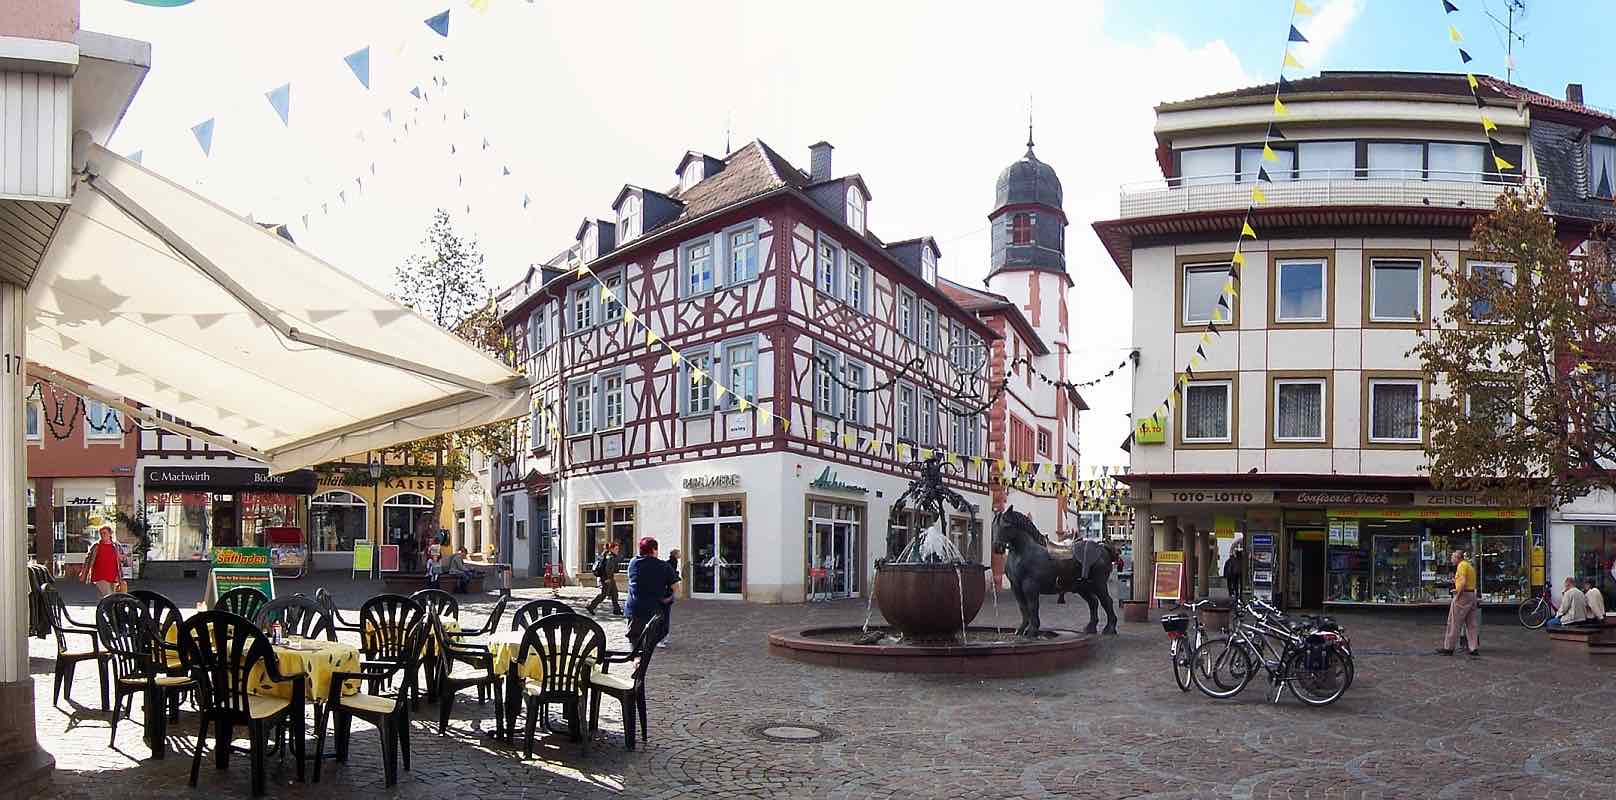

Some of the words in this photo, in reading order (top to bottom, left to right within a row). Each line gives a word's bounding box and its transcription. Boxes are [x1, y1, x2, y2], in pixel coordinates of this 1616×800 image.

[4, 353, 21, 375] 17
[161, 471, 210, 482] Machwirth
[384, 478, 446, 491] KAISE
